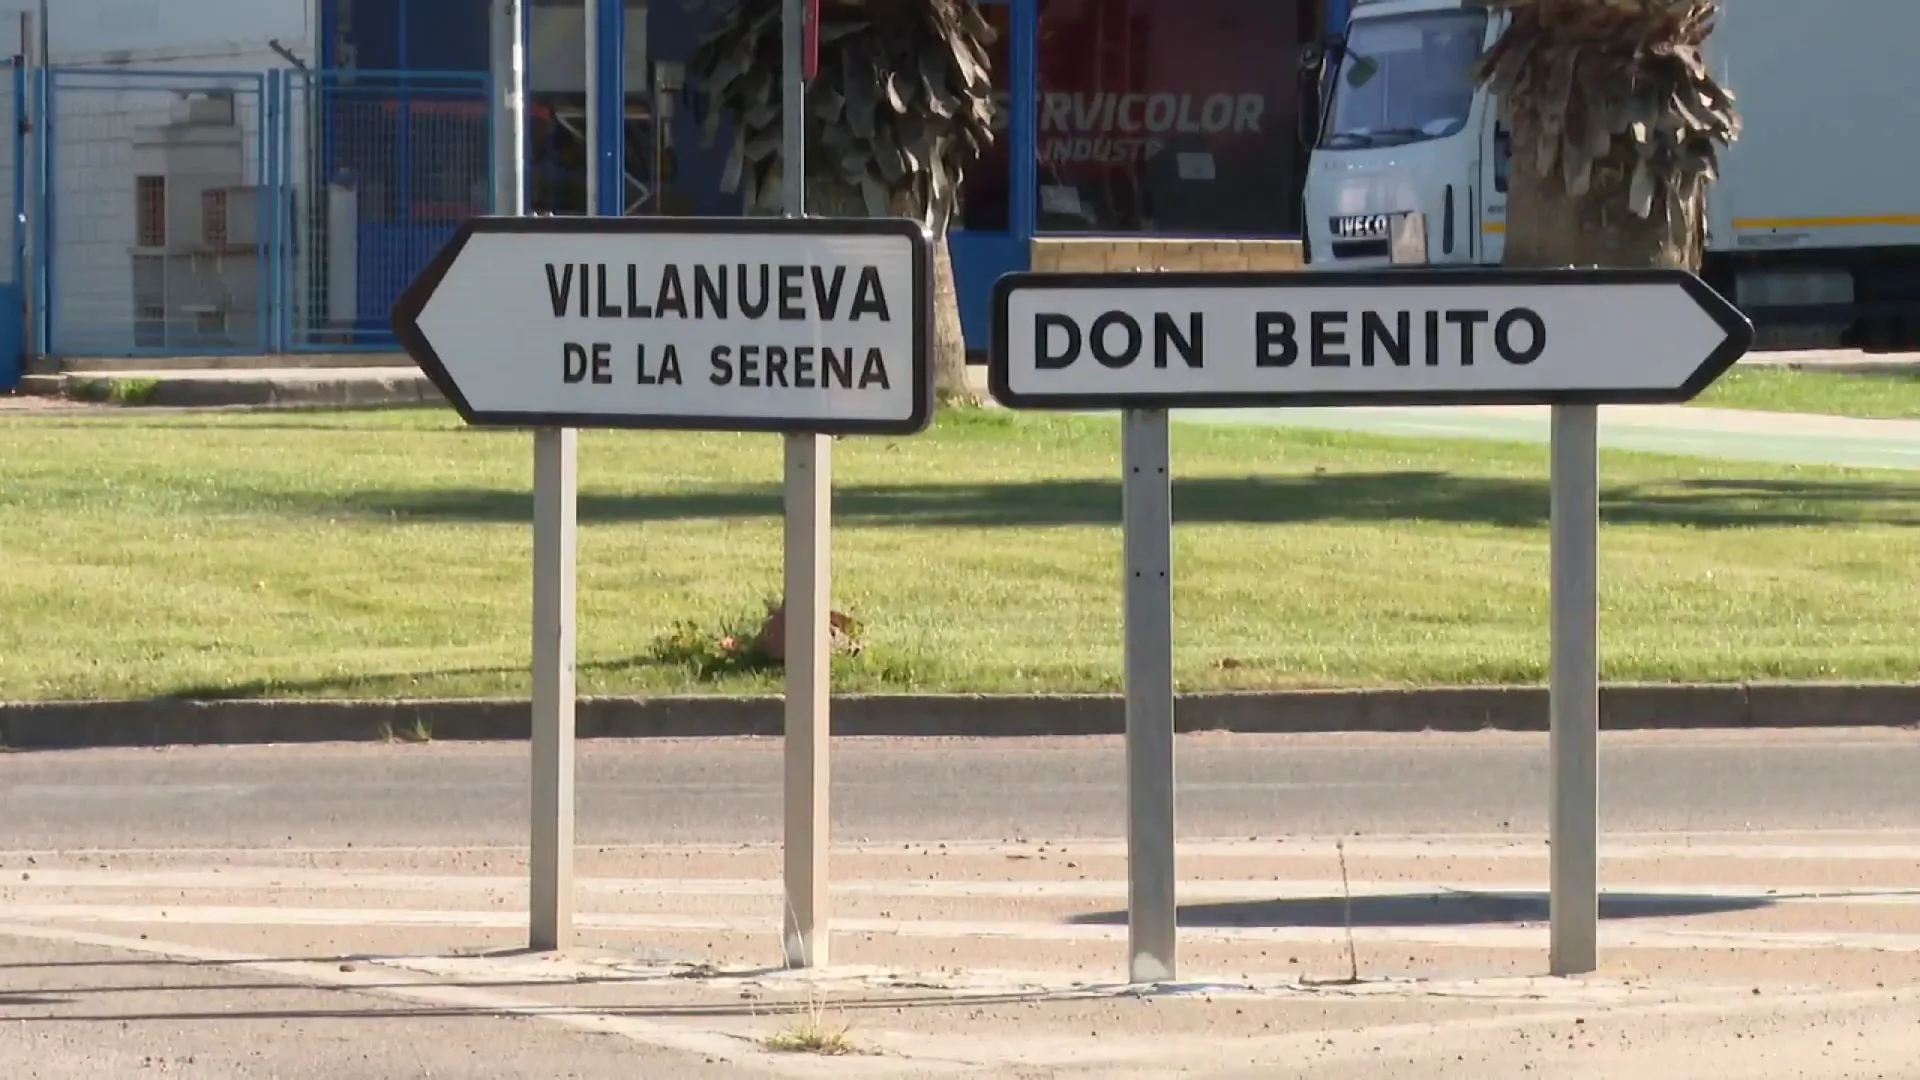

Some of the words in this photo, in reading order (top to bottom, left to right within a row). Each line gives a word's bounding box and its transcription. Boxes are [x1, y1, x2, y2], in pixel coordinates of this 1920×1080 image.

[991, 92, 1265, 133] SRVICOLOR
[1339, 215, 1388, 236] IVECO
[545, 263, 891, 322] VILLANUEVA
[1035, 310, 1204, 370] DON
[1256, 307, 1547, 368] BENITO
[563, 342, 613, 385] DE
[637, 343, 683, 386] LA
[709, 345, 891, 390] SERENA
